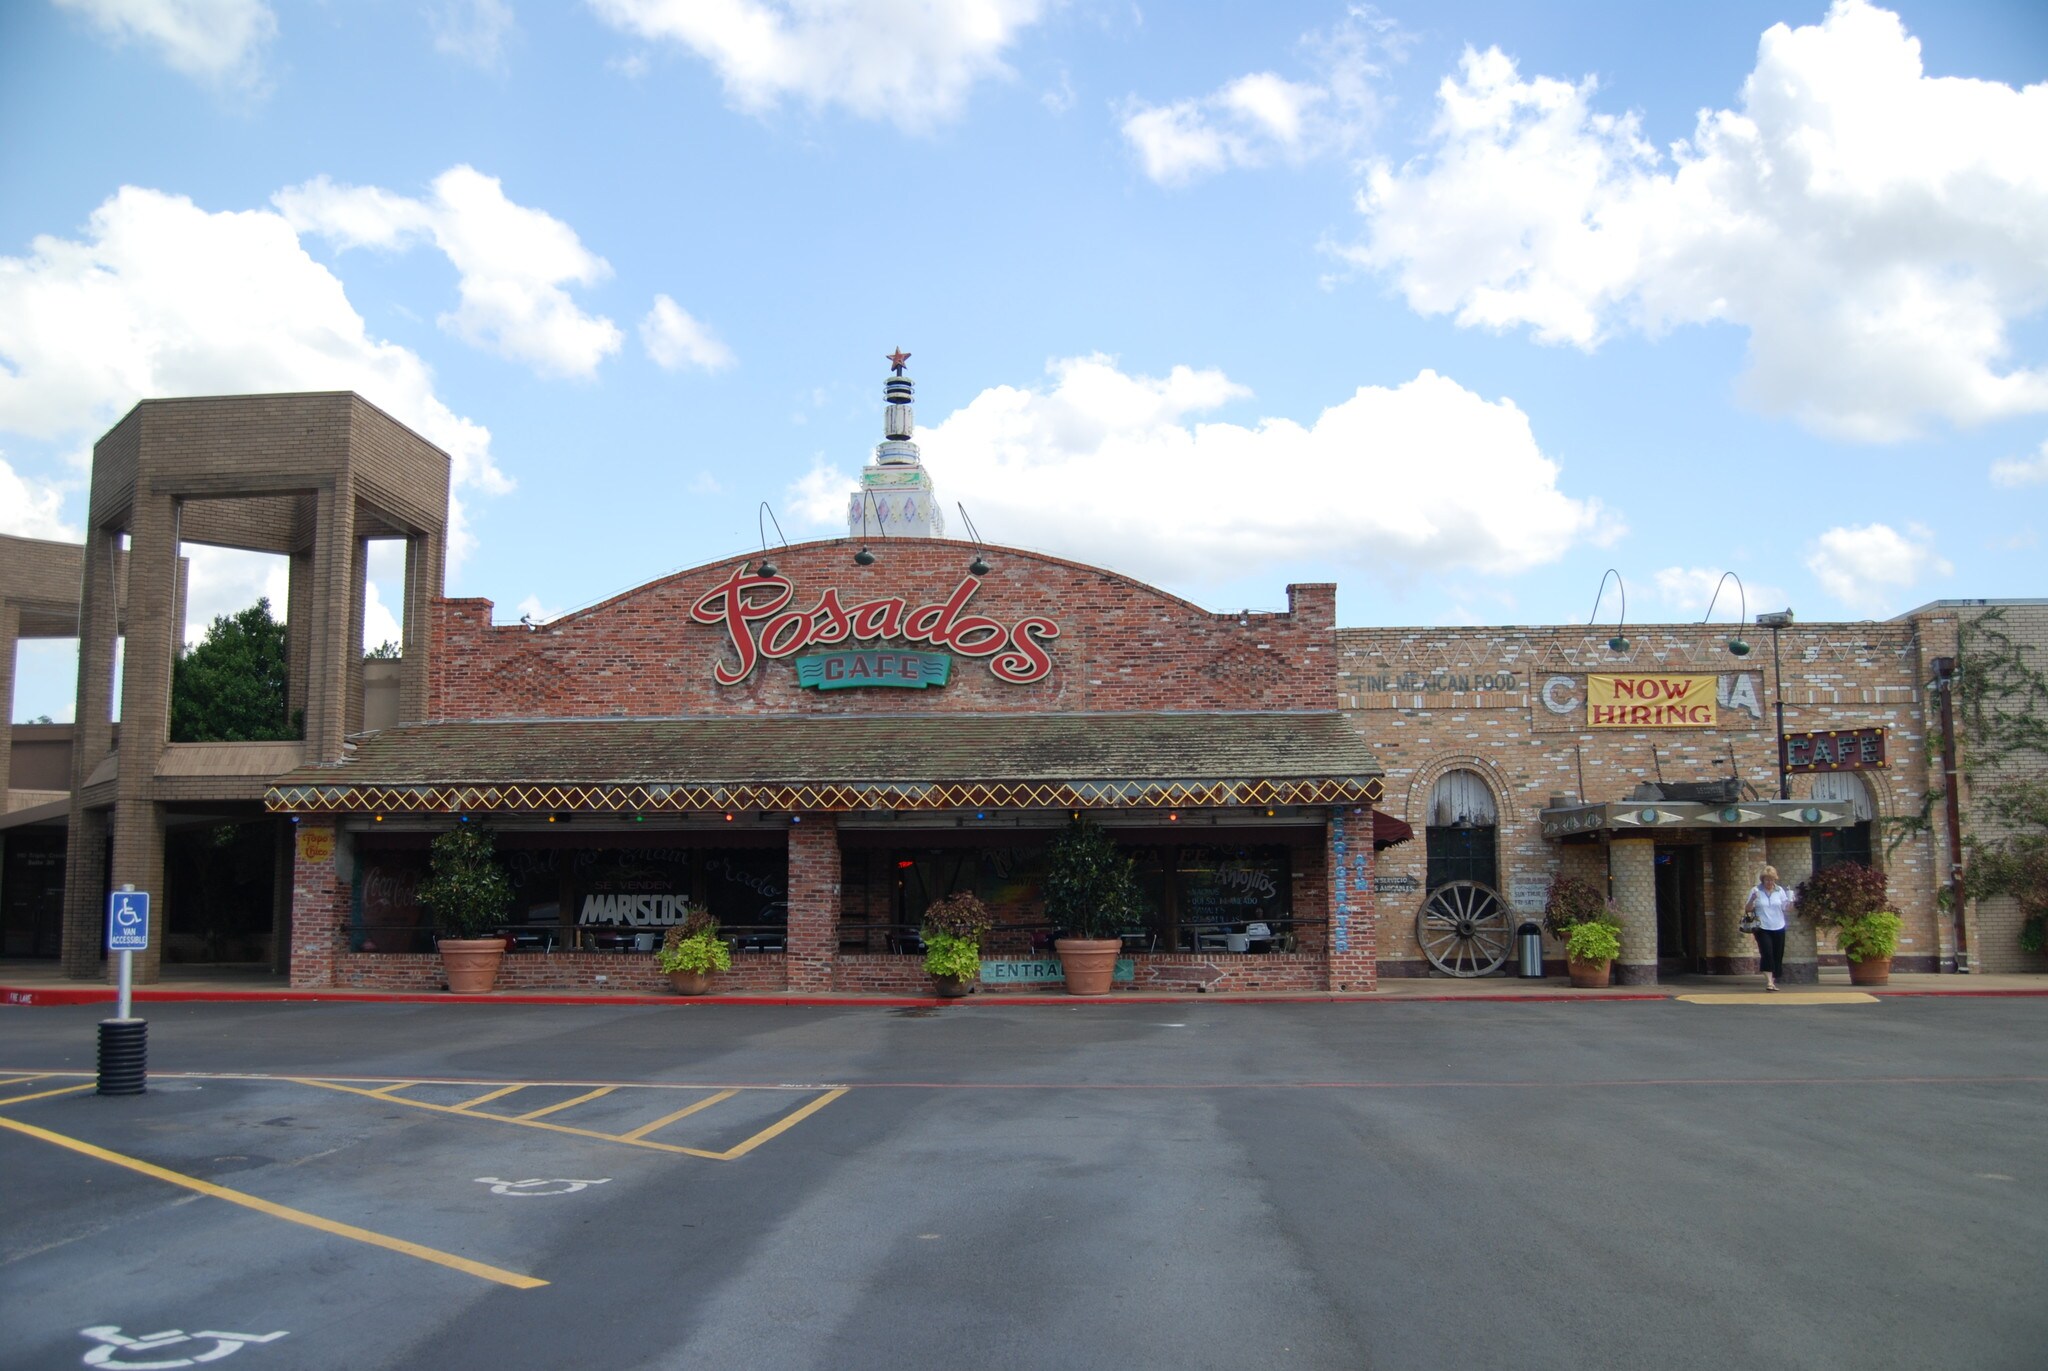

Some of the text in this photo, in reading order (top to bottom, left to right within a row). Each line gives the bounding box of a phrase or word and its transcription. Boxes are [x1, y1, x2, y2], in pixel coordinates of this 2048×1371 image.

[824, 655, 920, 681] CAFE
[1357, 673, 1517, 692] FINE MEXICAN FOOD
[1612, 678, 1693, 700] NOW
[1592, 704, 1712, 725] HIRING
[1787, 737, 1881, 766] CAFE
[303, 832, 329, 846] Topo
[306, 846, 329, 858] Chico
[619, 880, 673, 890] VENDEN
[579, 894, 690, 926] MARISCOS
[123, 927, 137, 936] VAN
[112, 935, 147, 945] ACCESSIBLE
[995, 964, 1065, 978] ENTRA
